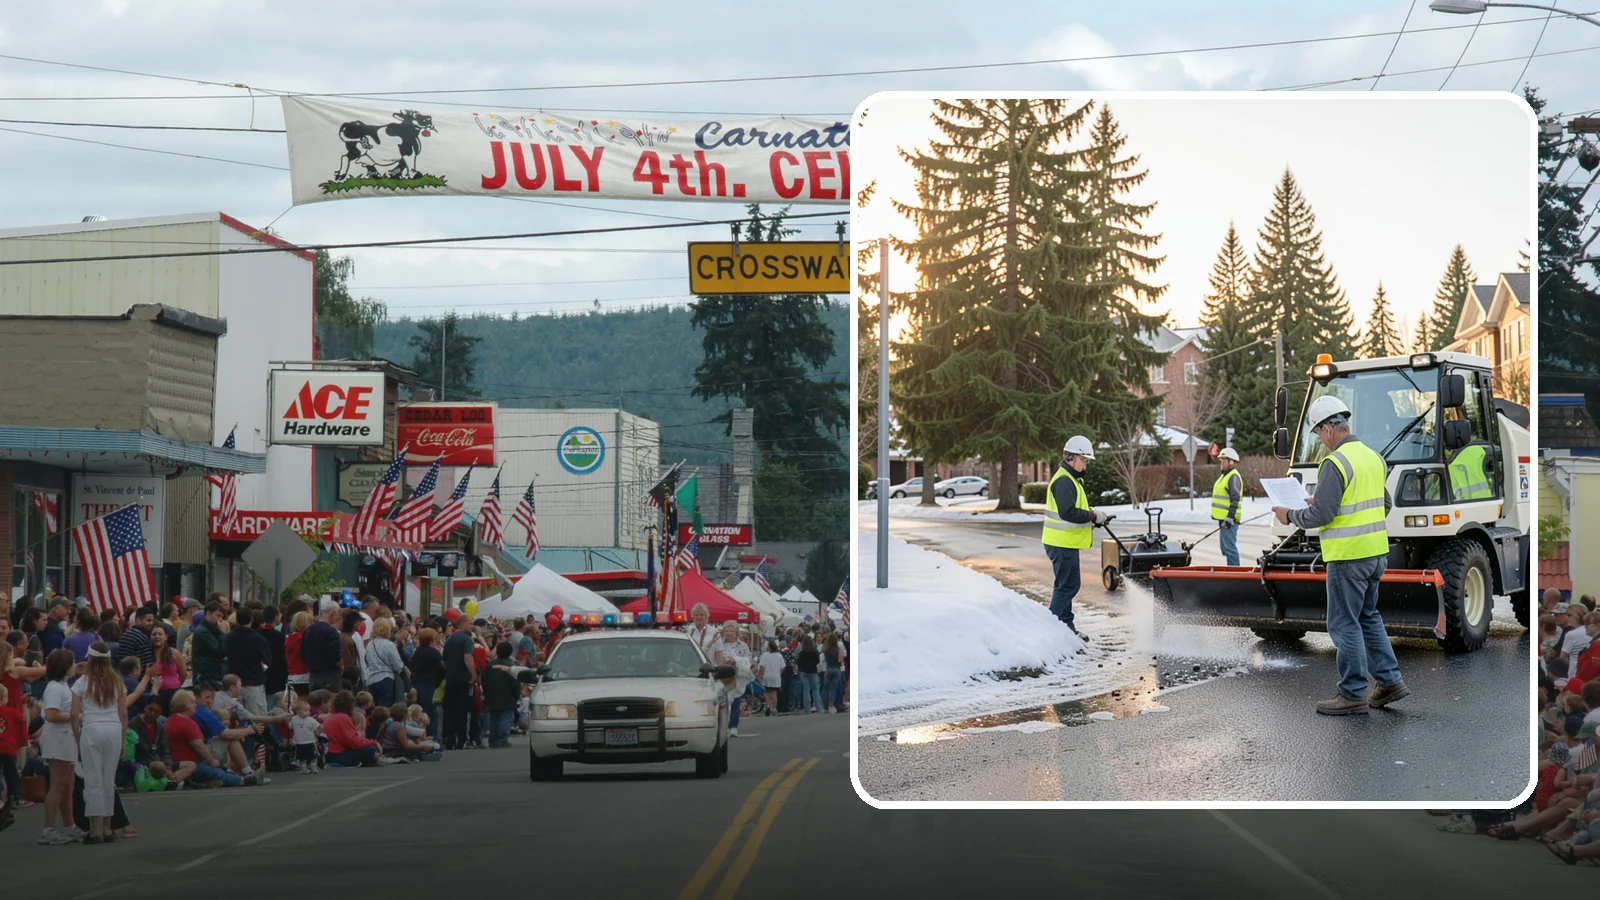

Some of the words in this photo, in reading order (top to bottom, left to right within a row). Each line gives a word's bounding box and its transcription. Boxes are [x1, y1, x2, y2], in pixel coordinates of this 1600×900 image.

[481, 141, 605, 192] JULY
[632, 150, 746, 198] 4th.
[697, 254, 850, 280] CROSSWA
[283, 380, 373, 420] ACE
[405, 409, 452, 422] CEDAR
[283, 421, 371, 436] Hardware
[416, 427, 477, 447] Coca-Cola
[83, 484, 93, 494] St.
[96, 485, 124, 495] Vincent
[126, 486, 136, 495] de
[138, 486, 155, 495] Paul
[688, 526, 741, 535] CRNATION
[699, 535, 730, 543] GLASS
